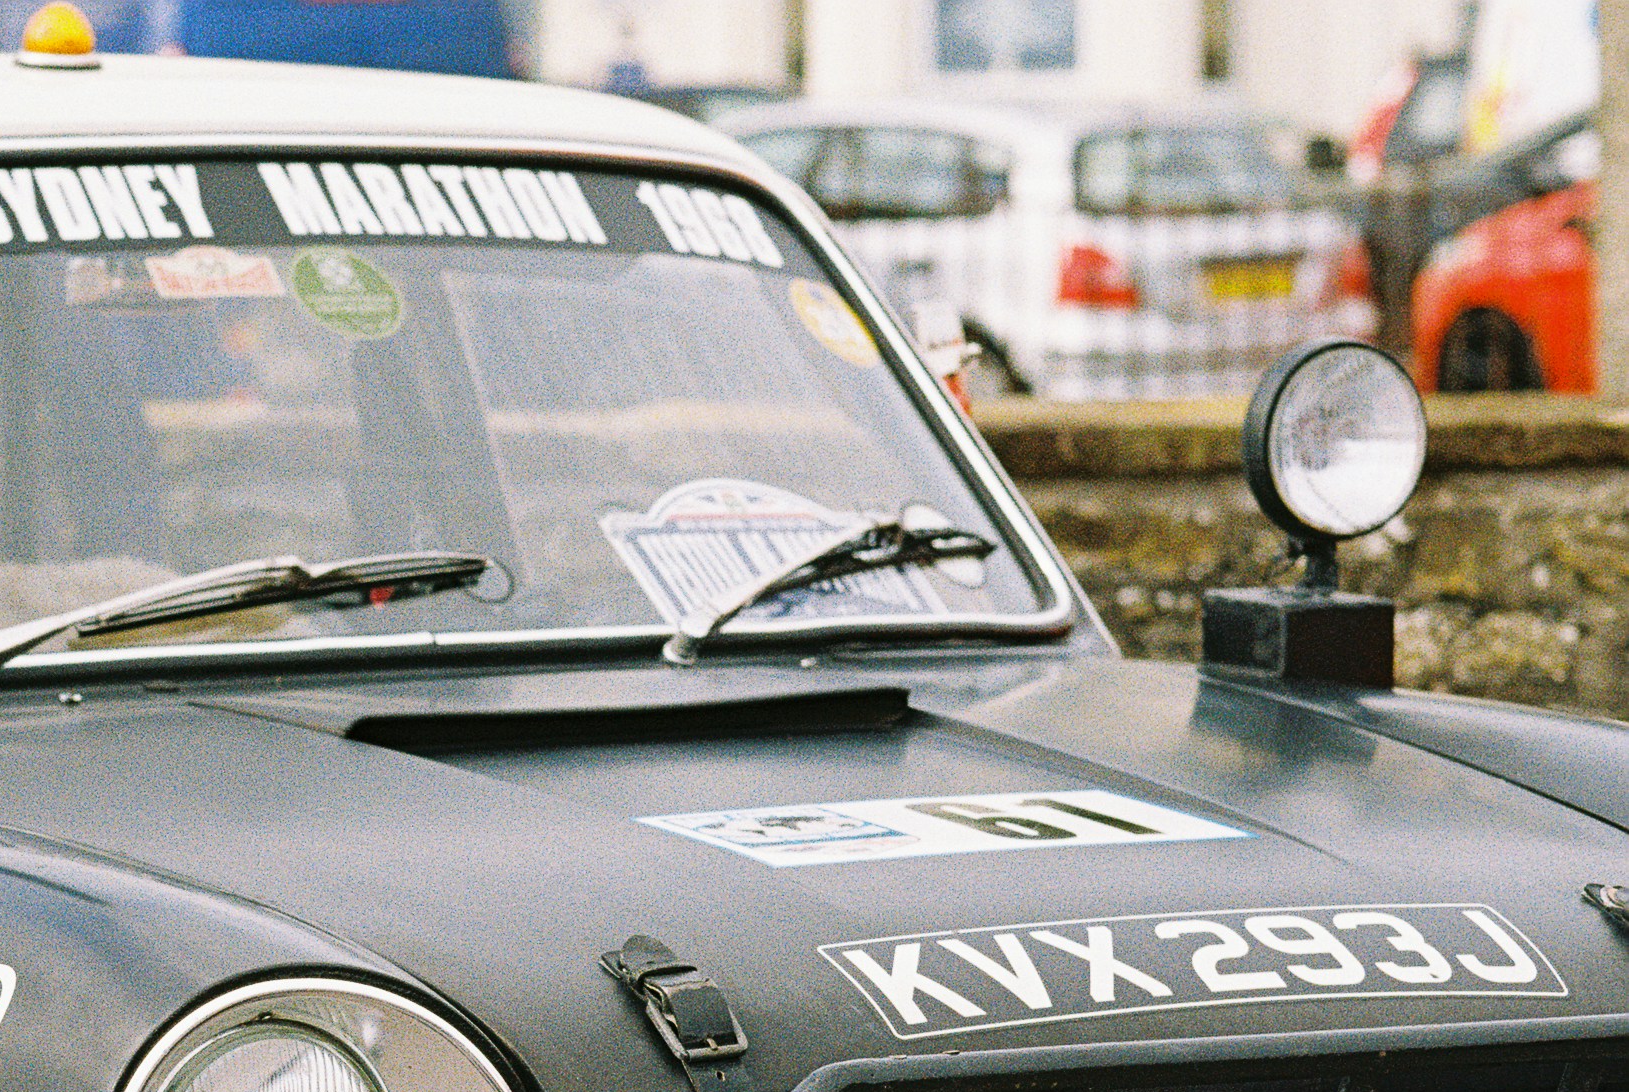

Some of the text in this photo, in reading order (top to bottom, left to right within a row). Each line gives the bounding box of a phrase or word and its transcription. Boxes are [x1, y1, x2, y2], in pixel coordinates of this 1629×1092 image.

[257, 162, 609, 246] MARATHON
[635, 180, 793, 270] 1968
[904, 798, 1166, 843] 61
[841, 908, 1539, 1027] KVX 293J
